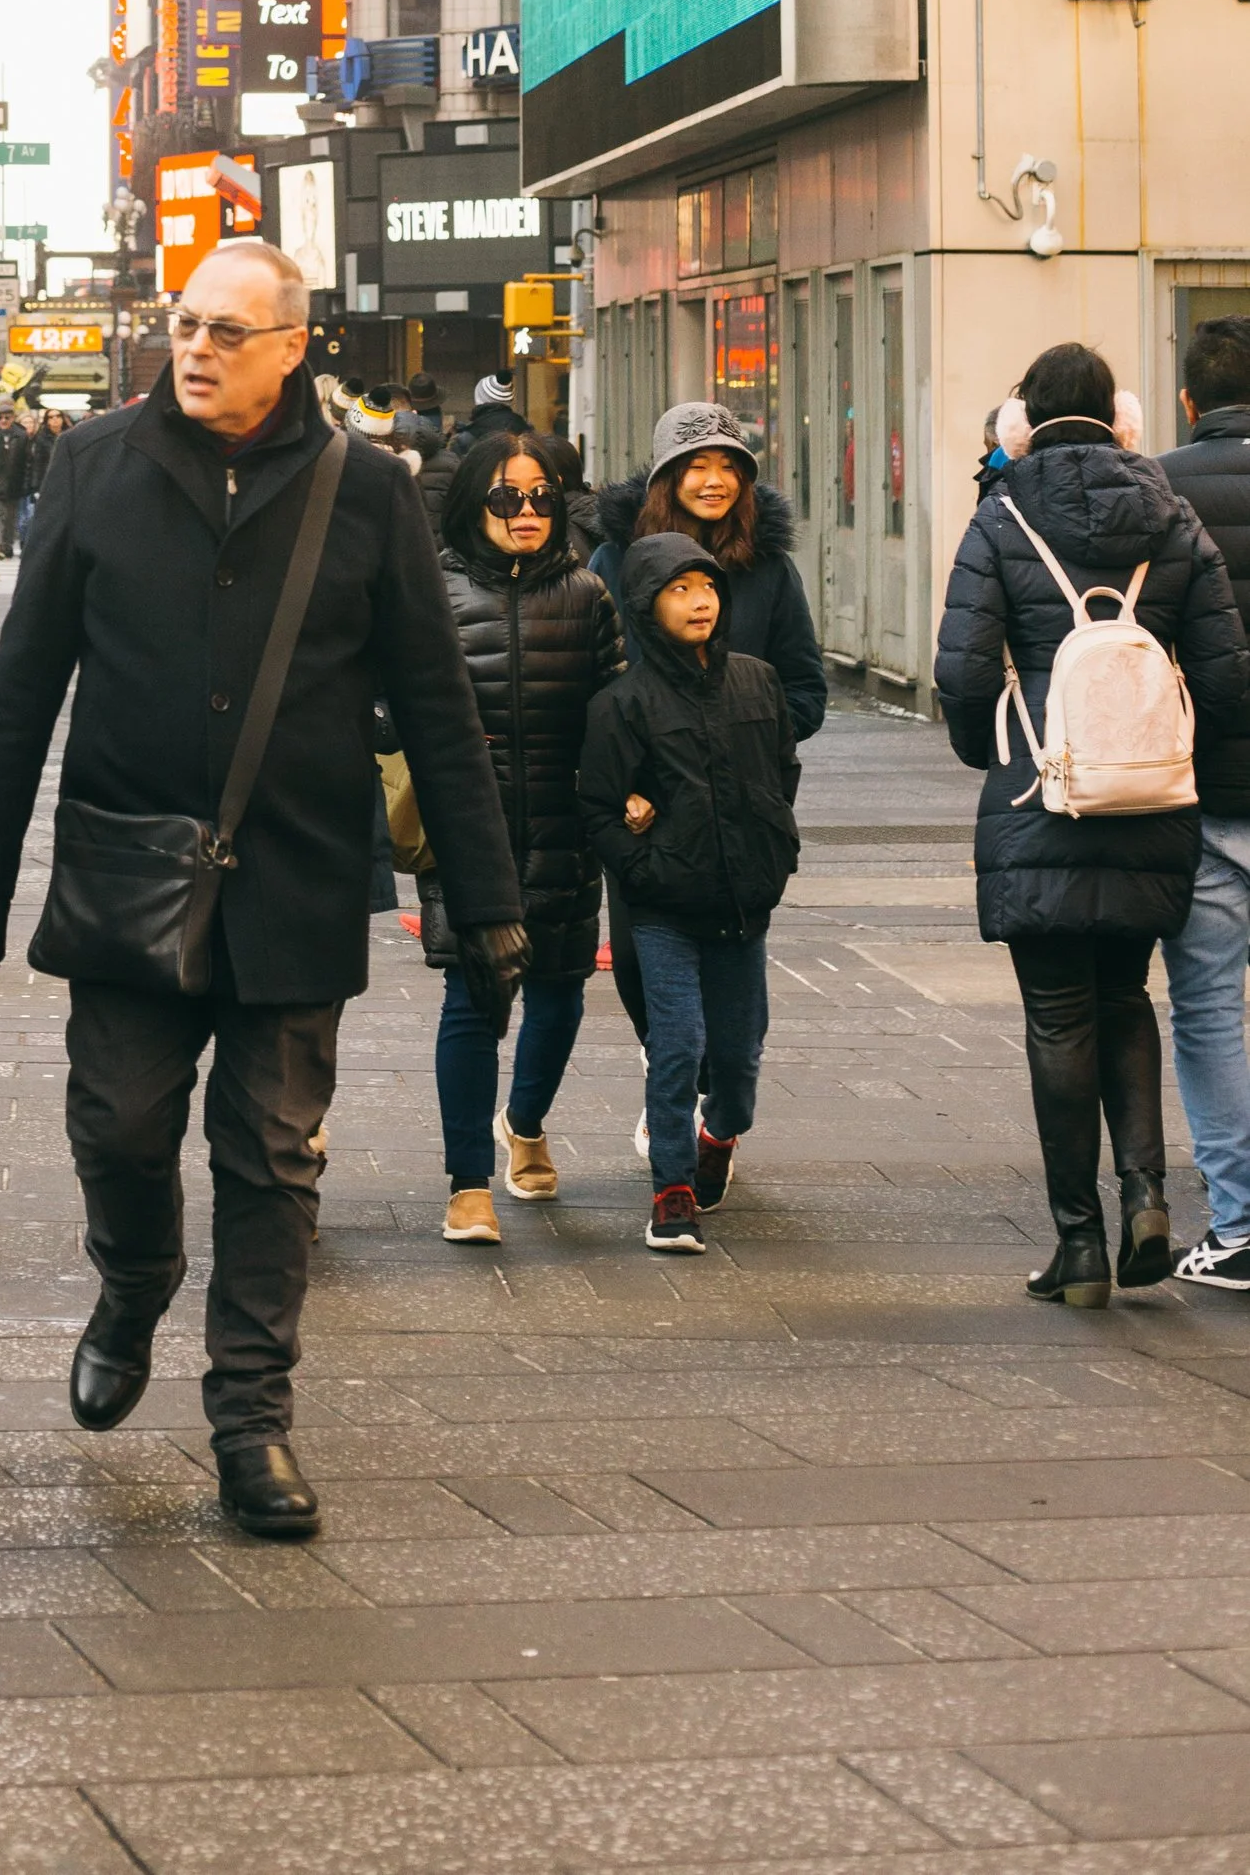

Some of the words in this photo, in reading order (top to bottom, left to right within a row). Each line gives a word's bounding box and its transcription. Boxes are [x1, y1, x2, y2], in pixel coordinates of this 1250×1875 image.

[266, 54, 299, 81] To
[461, 30, 520, 79] HA
[6, 144, 15, 163] 7
[20, 145, 36, 157] Av
[386, 200, 450, 242] STEVE
[453, 197, 541, 240] MADDEN
